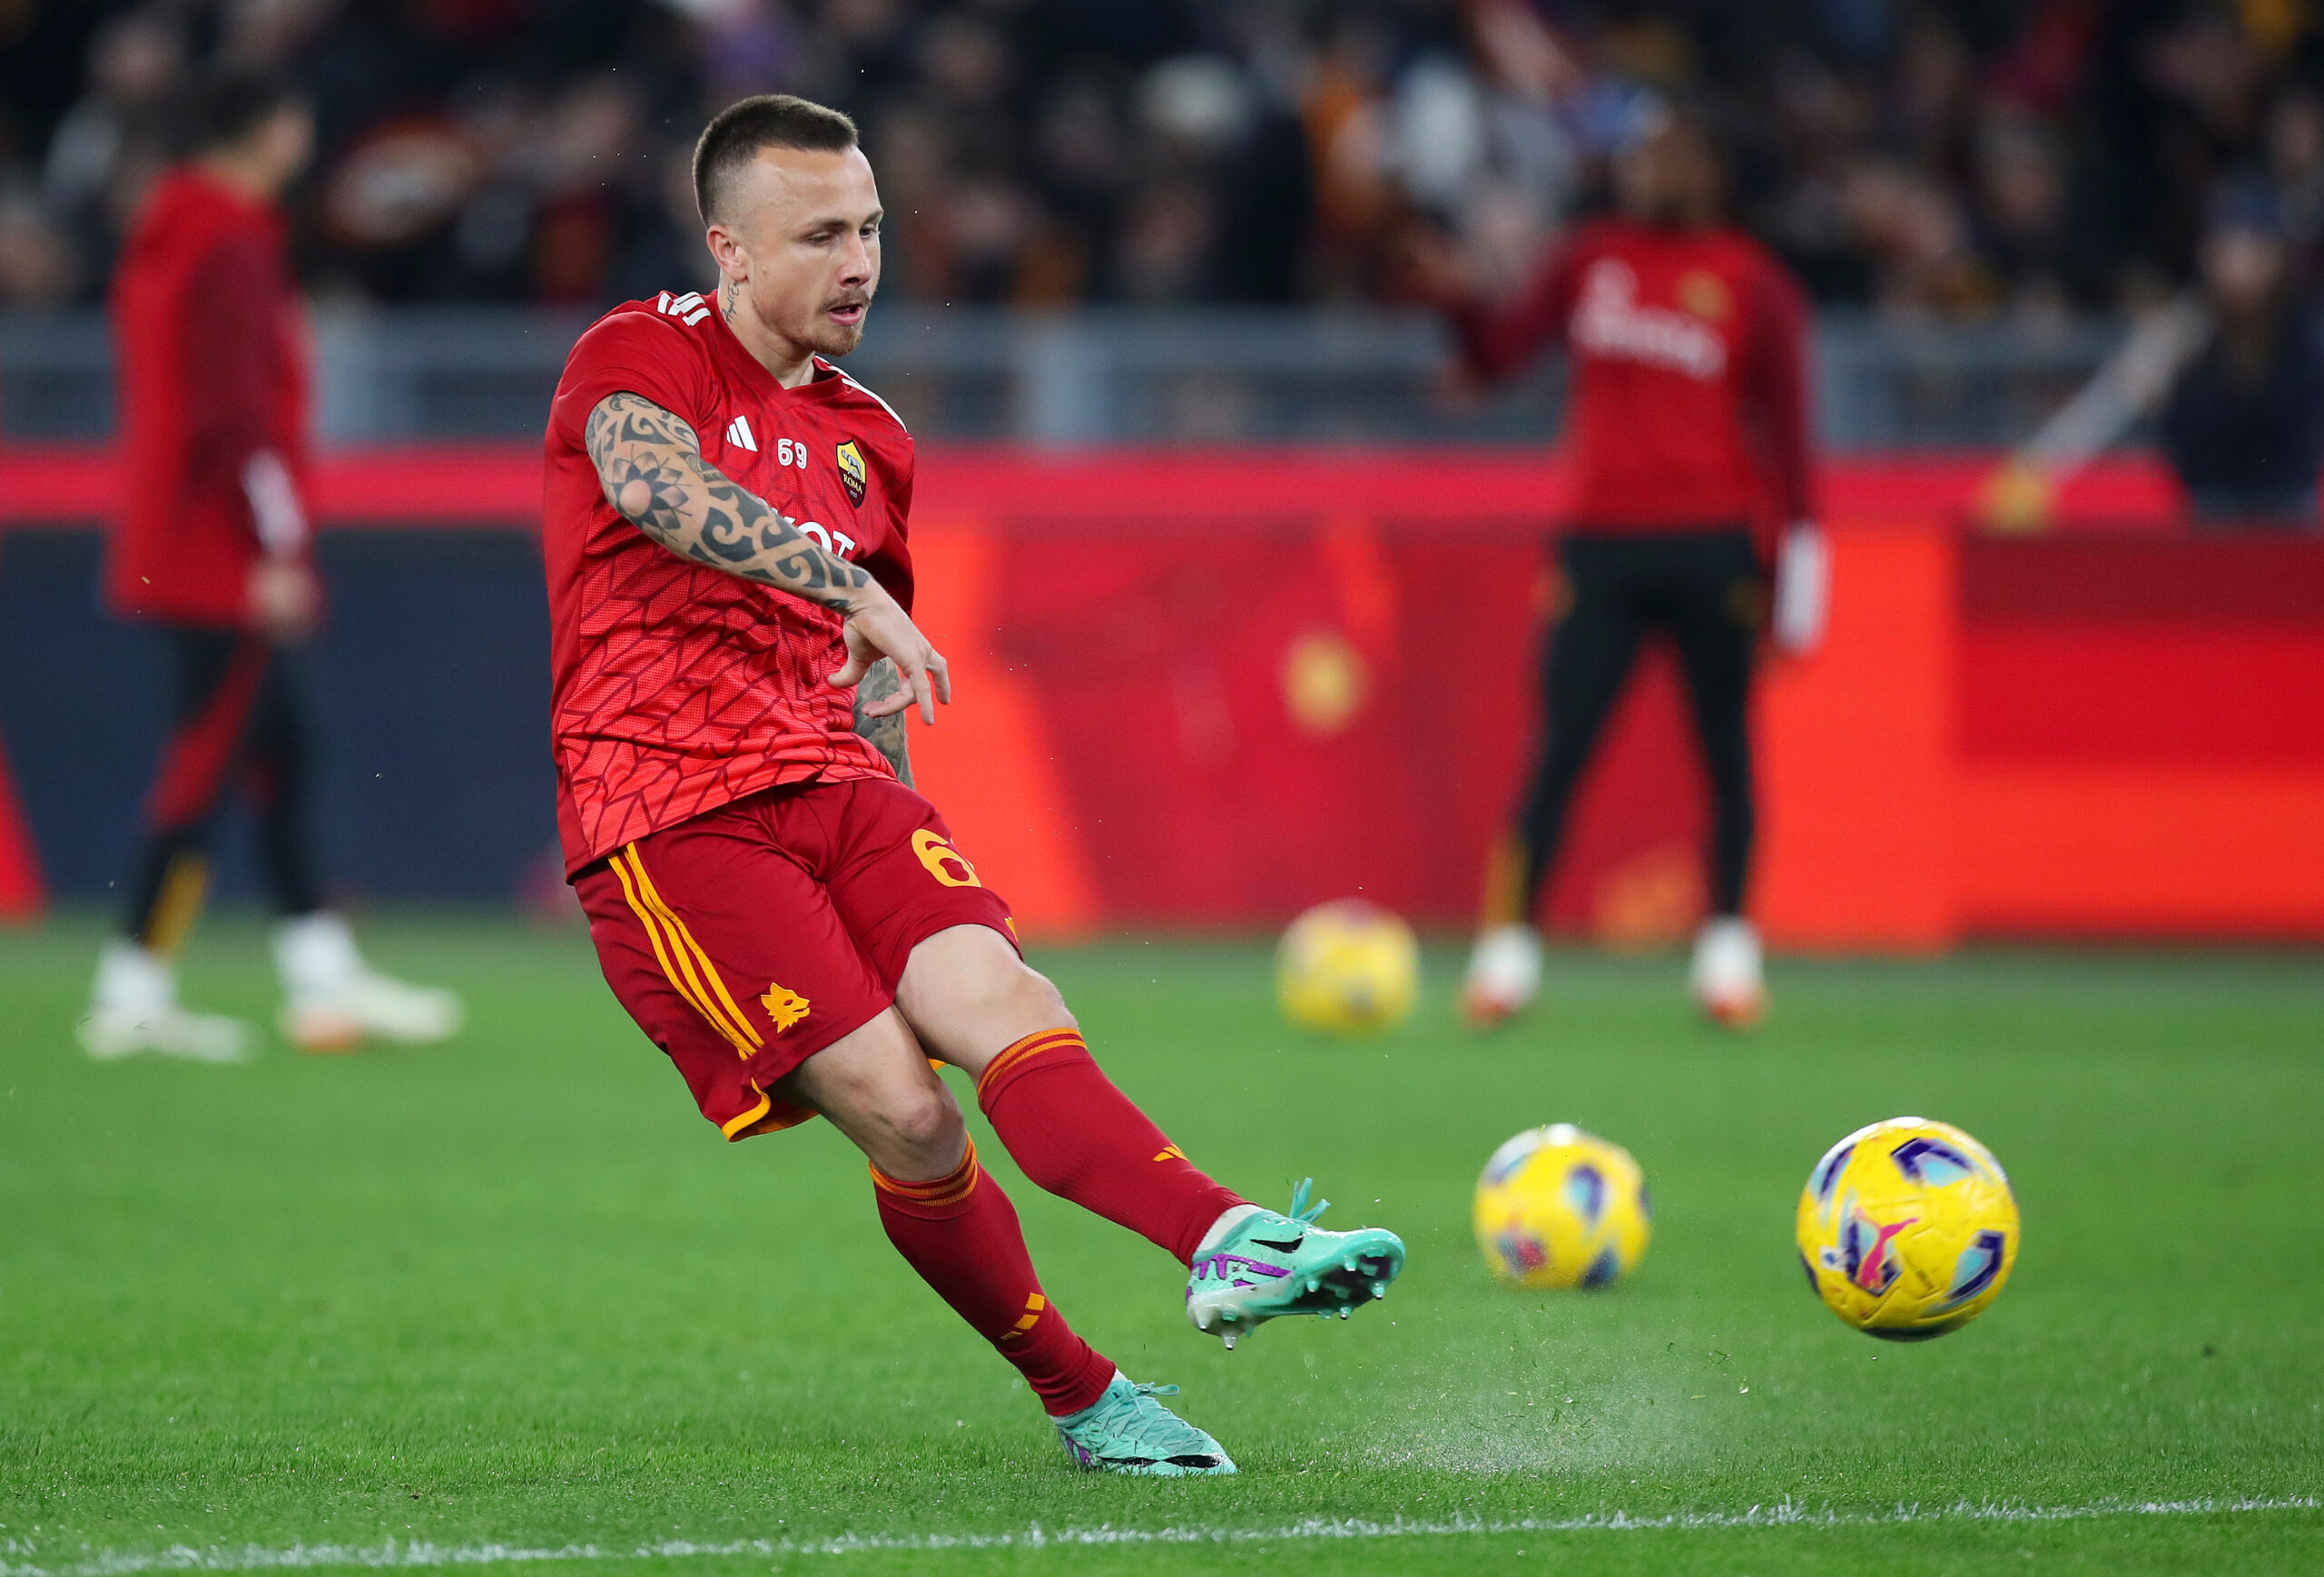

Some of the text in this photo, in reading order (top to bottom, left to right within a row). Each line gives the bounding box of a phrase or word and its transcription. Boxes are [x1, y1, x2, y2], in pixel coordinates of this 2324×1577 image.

[777, 438, 807, 469] 69
[842, 473, 862, 495] ROMA
[911, 828, 982, 888] 6
